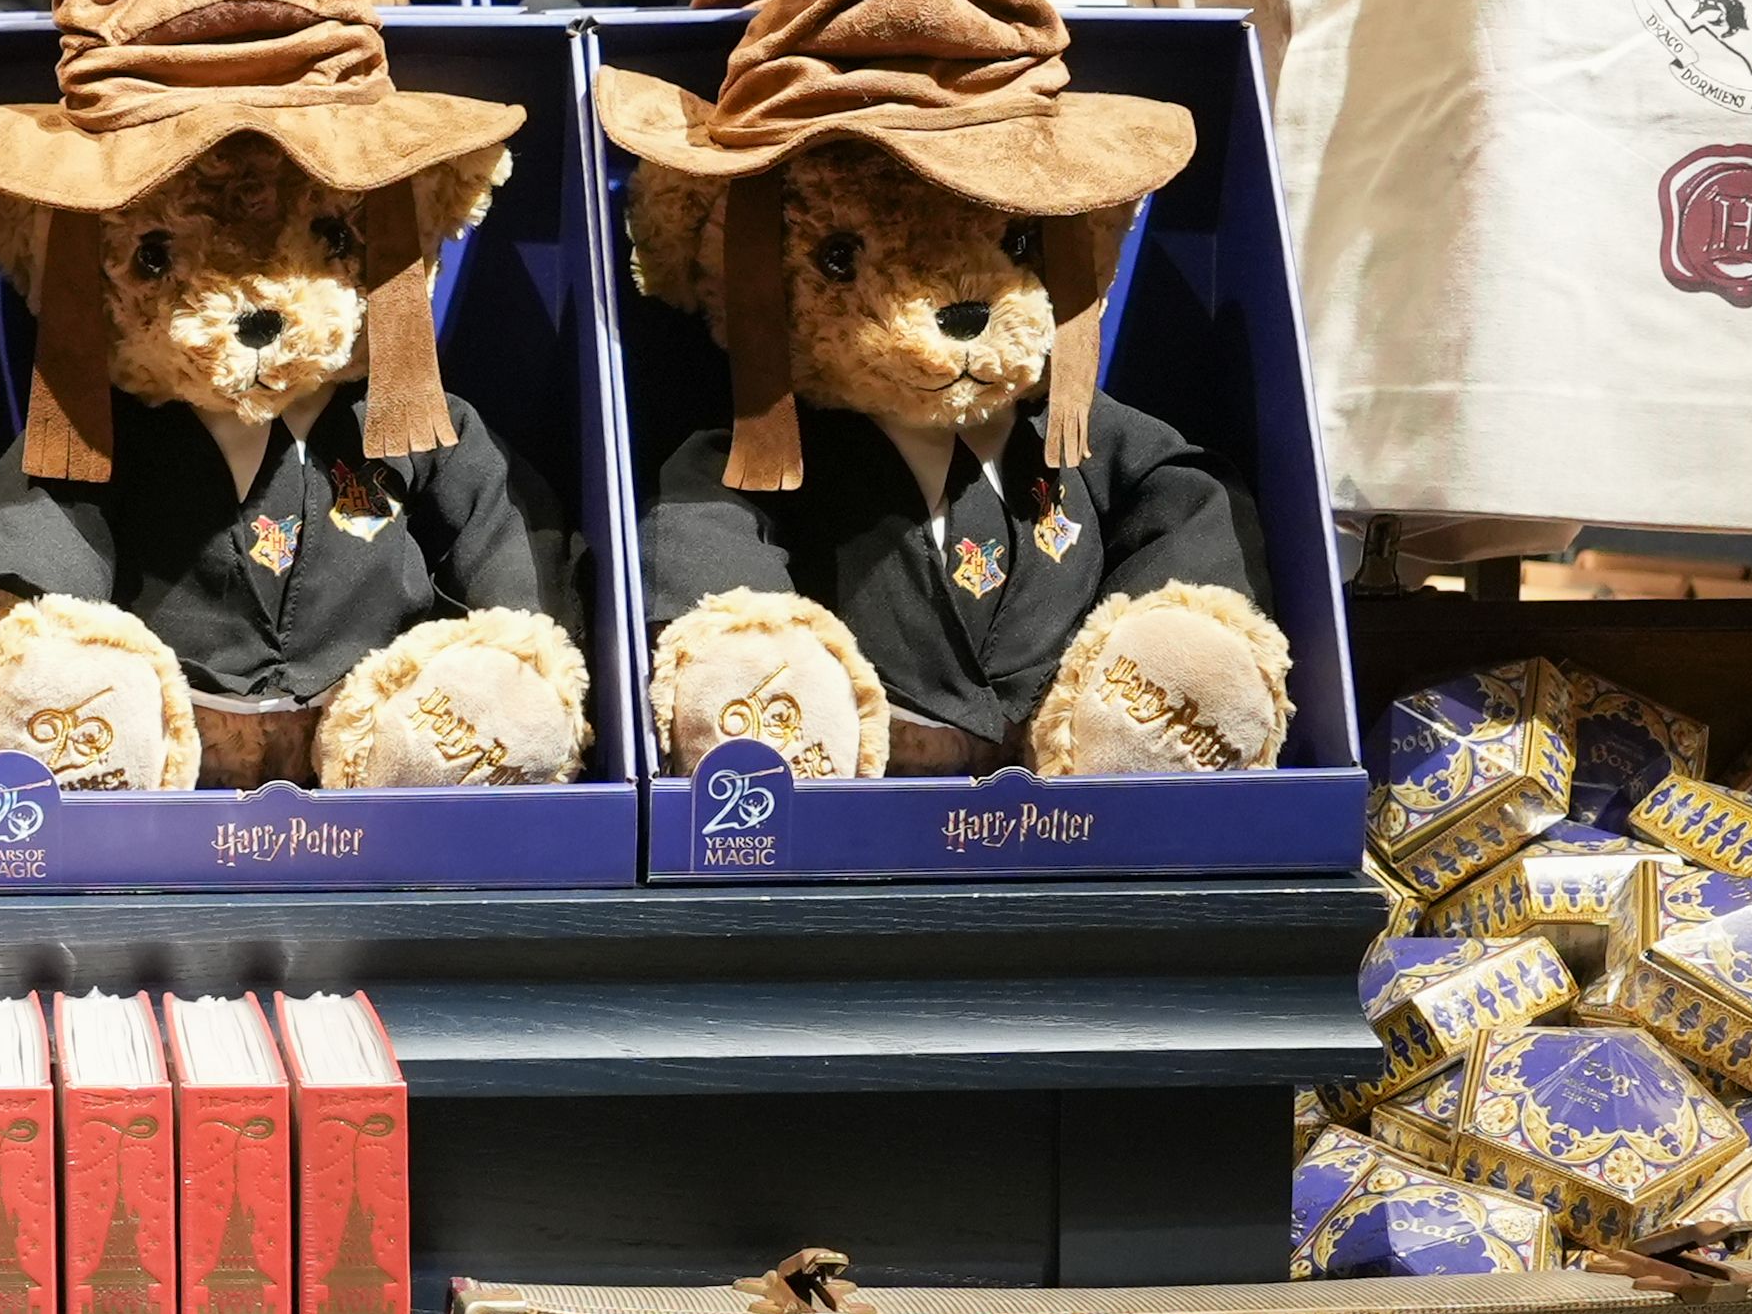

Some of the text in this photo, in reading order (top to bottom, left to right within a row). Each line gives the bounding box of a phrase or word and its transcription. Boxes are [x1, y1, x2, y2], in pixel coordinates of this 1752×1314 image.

[1646, 14, 1684, 54] DRACO
[1680, 68, 1745, 109] DORMIENS
[1102, 654, 1169, 723] Harry
[701, 766, 785, 836] 25
[212, 817, 364, 867] Harry Potter
[704, 836, 775, 849] YEARS OF
[942, 803, 1094, 852] Harry Potter
[24, 850, 46, 862] OF
[703, 849, 776, 866] MAGIC
